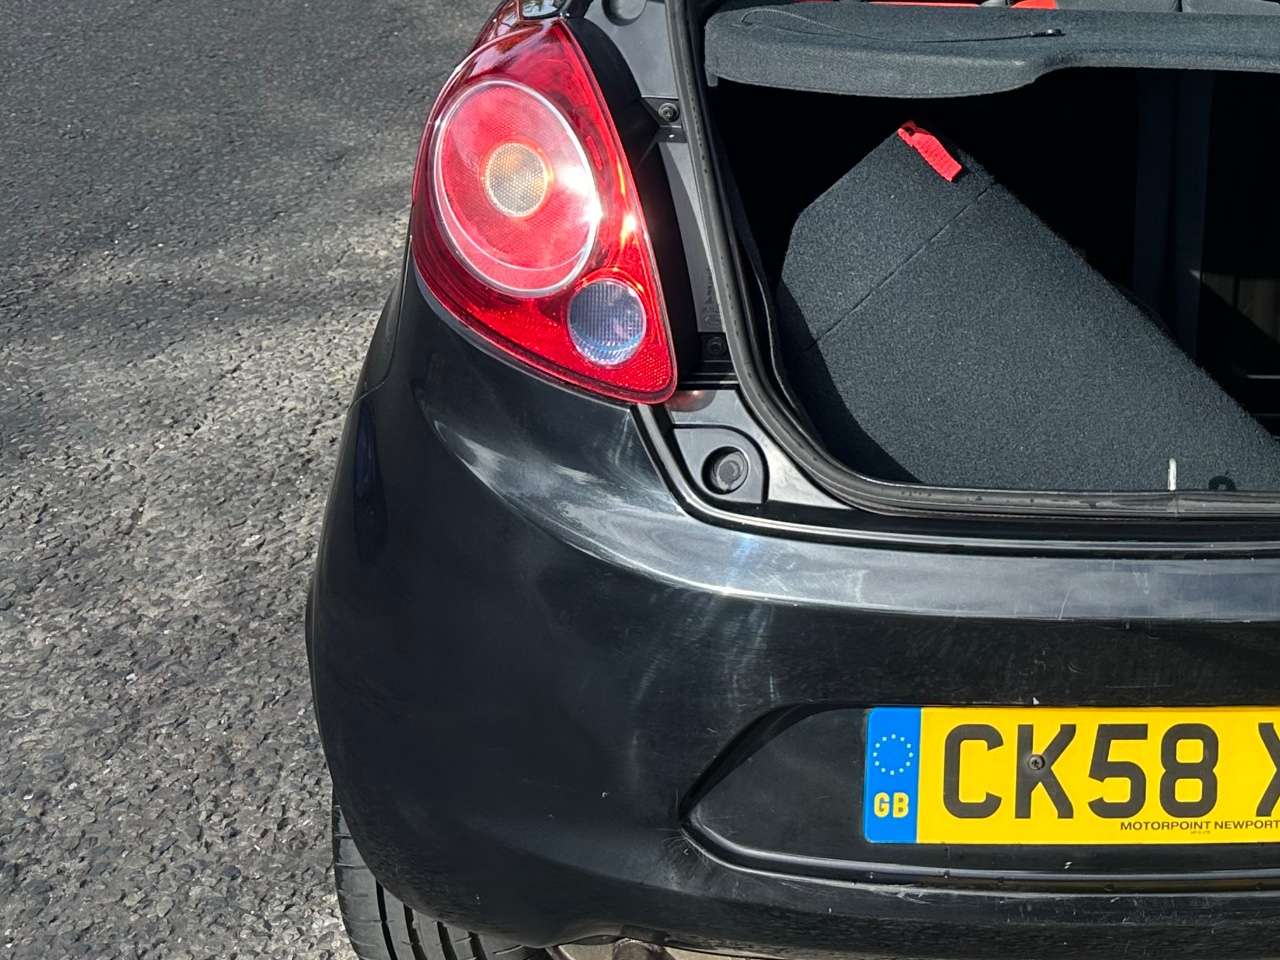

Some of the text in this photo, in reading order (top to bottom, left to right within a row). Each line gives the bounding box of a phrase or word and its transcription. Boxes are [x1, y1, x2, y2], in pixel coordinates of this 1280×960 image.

[942, 722, 1220, 819] CK58
[874, 792, 909, 818] GB
[1120, 819, 1280, 831] MOTORPOINT NEWPORT
